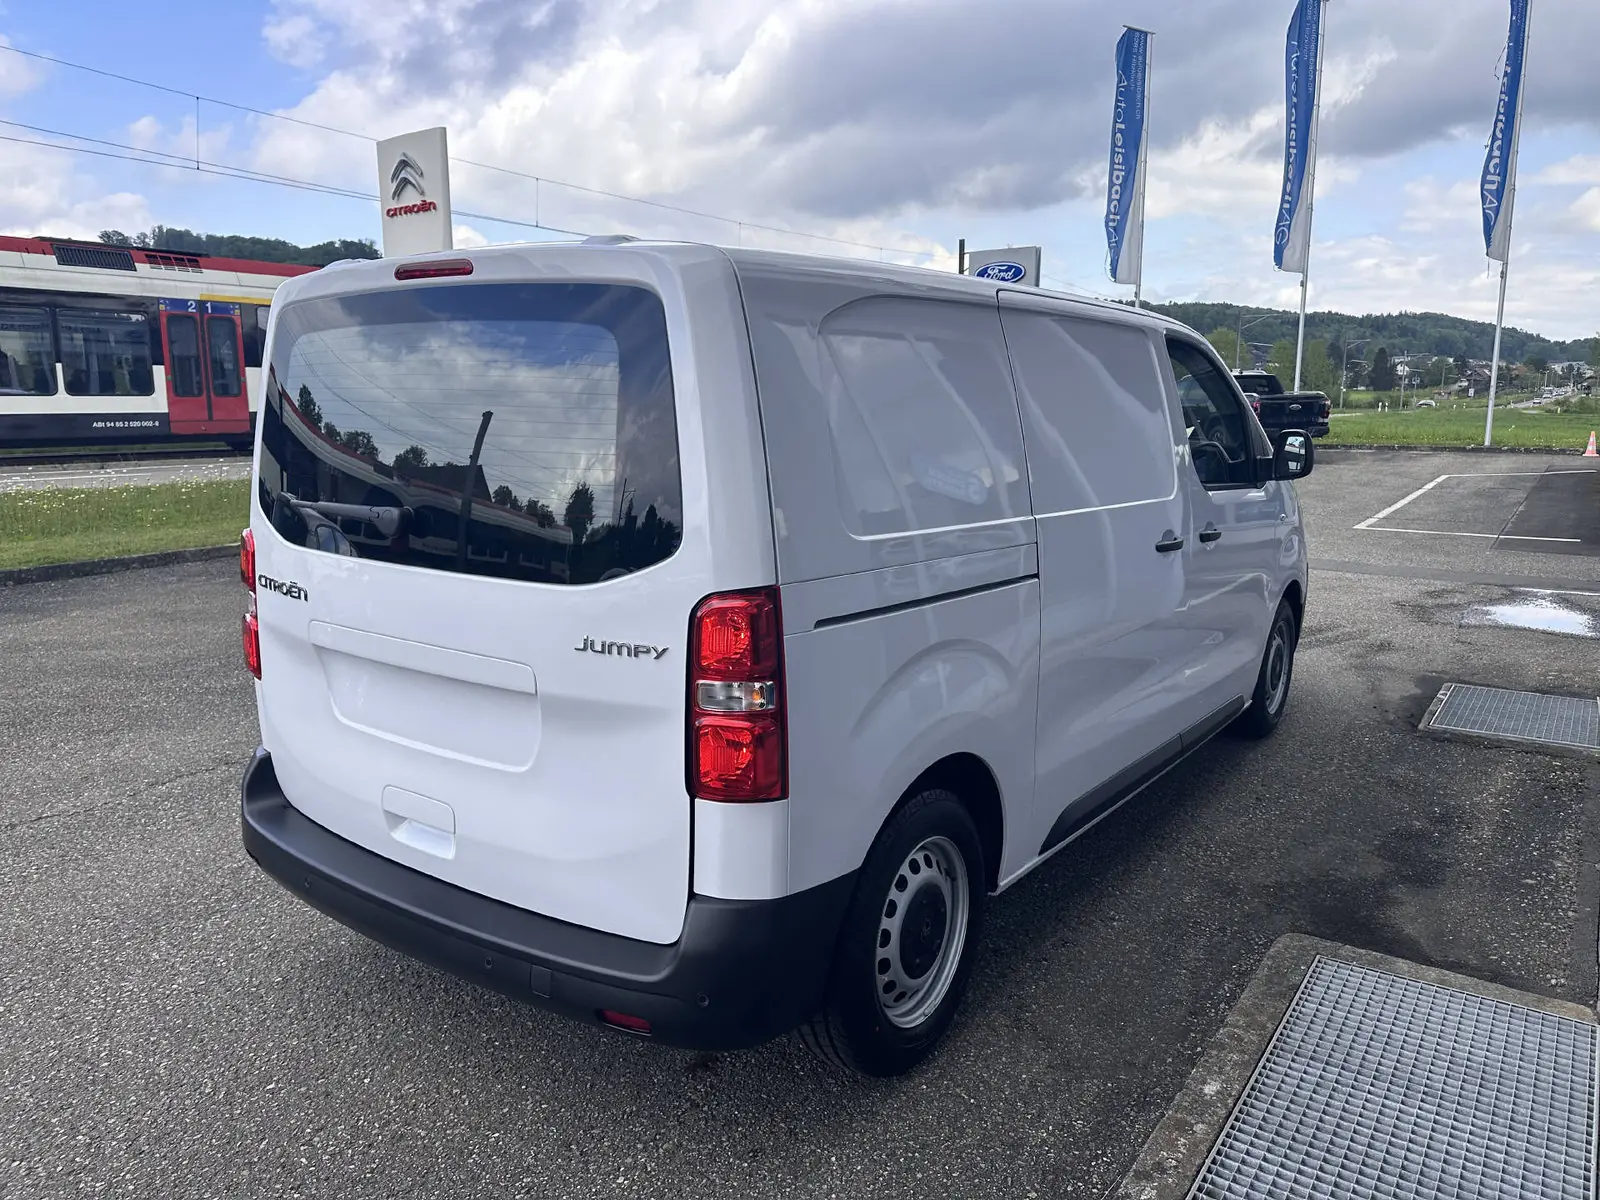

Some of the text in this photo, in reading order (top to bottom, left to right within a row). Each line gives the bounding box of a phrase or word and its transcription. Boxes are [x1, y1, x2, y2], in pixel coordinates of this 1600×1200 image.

[985, 265, 1015, 280] Ford
[187, 300, 212, 314] 2 1
